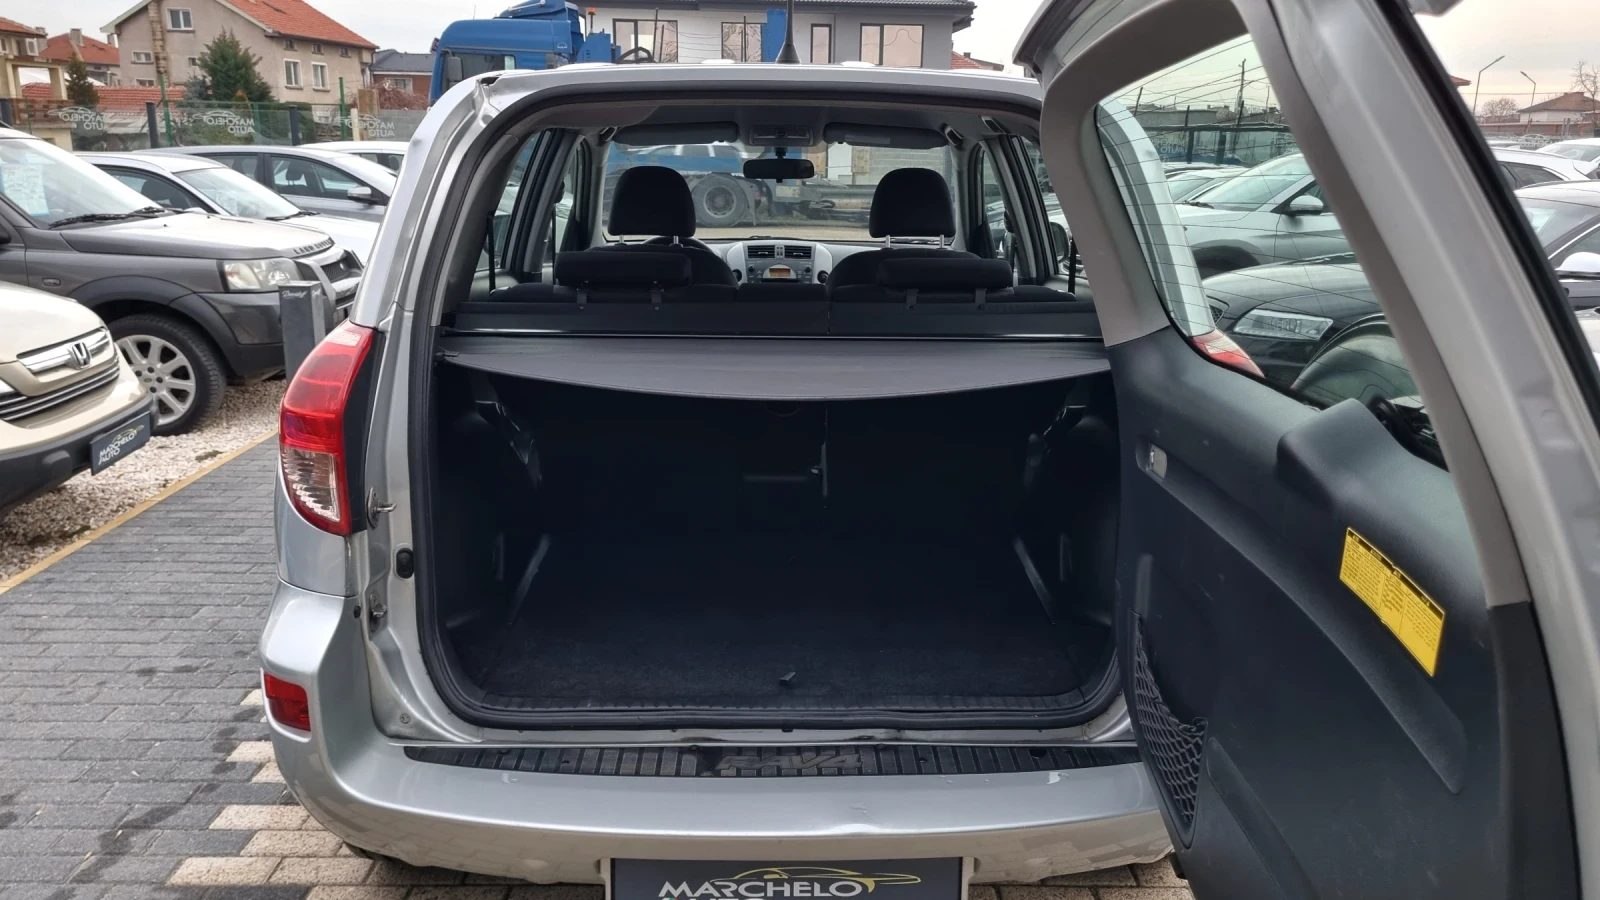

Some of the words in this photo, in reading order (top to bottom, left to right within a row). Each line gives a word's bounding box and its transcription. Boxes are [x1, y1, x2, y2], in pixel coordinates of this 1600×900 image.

[98, 447, 121, 466] AUTO
[714, 753, 864, 771] RAV4
[657, 880, 863, 898] MARCHELO
